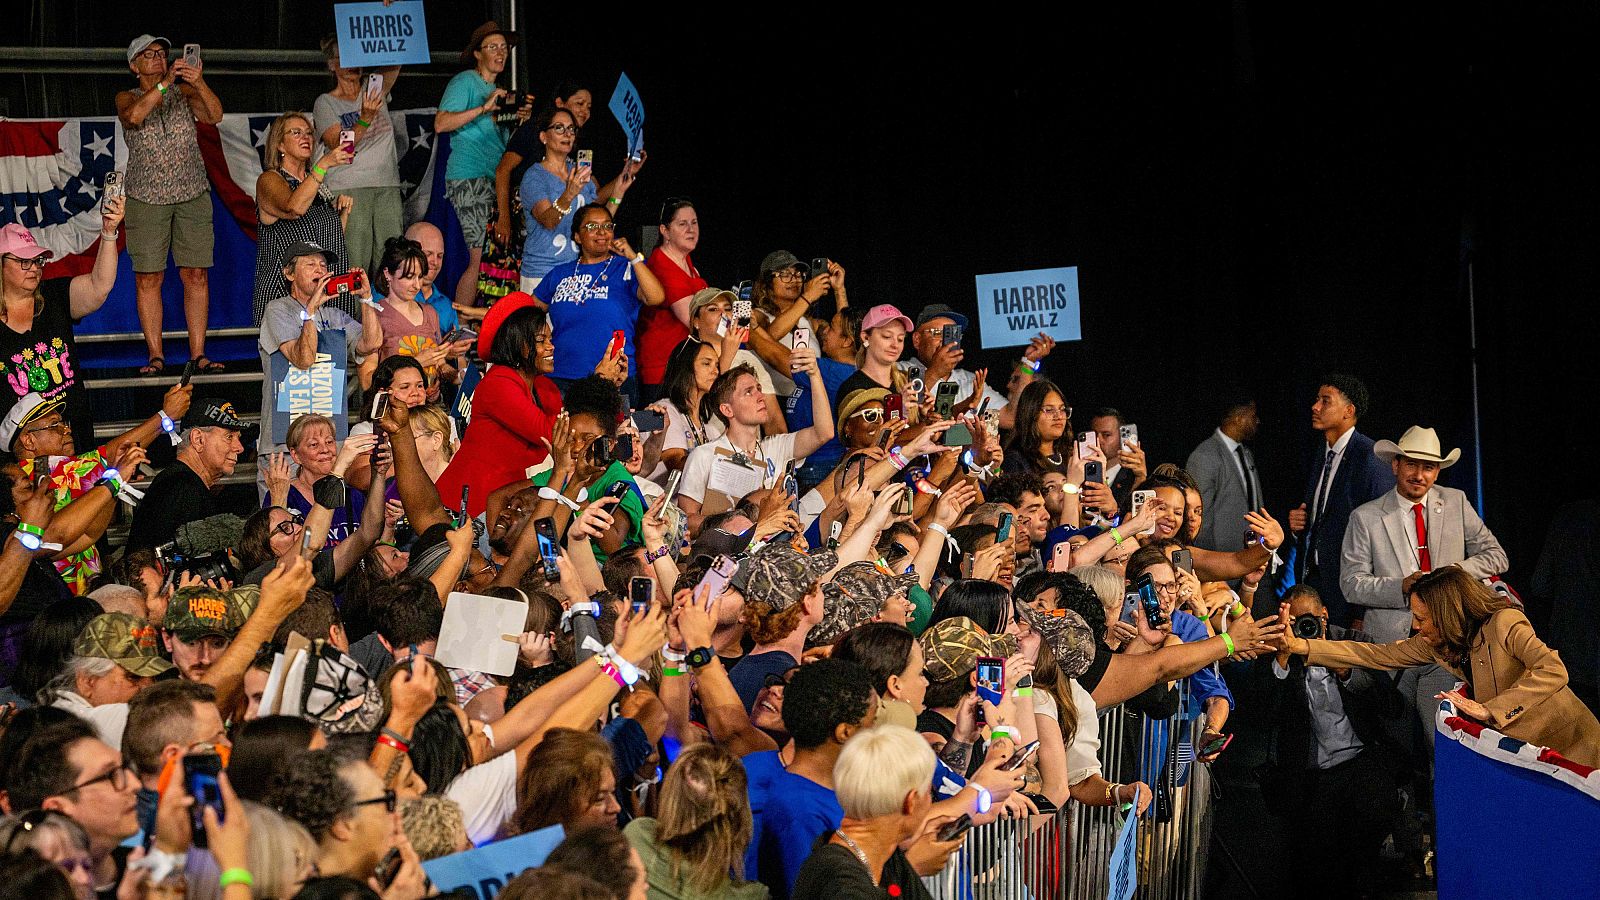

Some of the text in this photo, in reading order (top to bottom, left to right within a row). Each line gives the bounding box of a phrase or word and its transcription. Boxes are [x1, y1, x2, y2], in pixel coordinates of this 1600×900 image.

[349, 14, 414, 39] HARRIS
[361, 39, 407, 54] WALZ
[559, 274, 593, 285] PROUD
[993, 283, 1067, 315] HARRIS
[1007, 312, 1058, 331] WALZ
[8, 352, 74, 396] VOTE
[204, 404, 251, 428] VETERAN
[189, 598, 226, 614] HARRIS
[195, 609, 223, 621] WALZ
